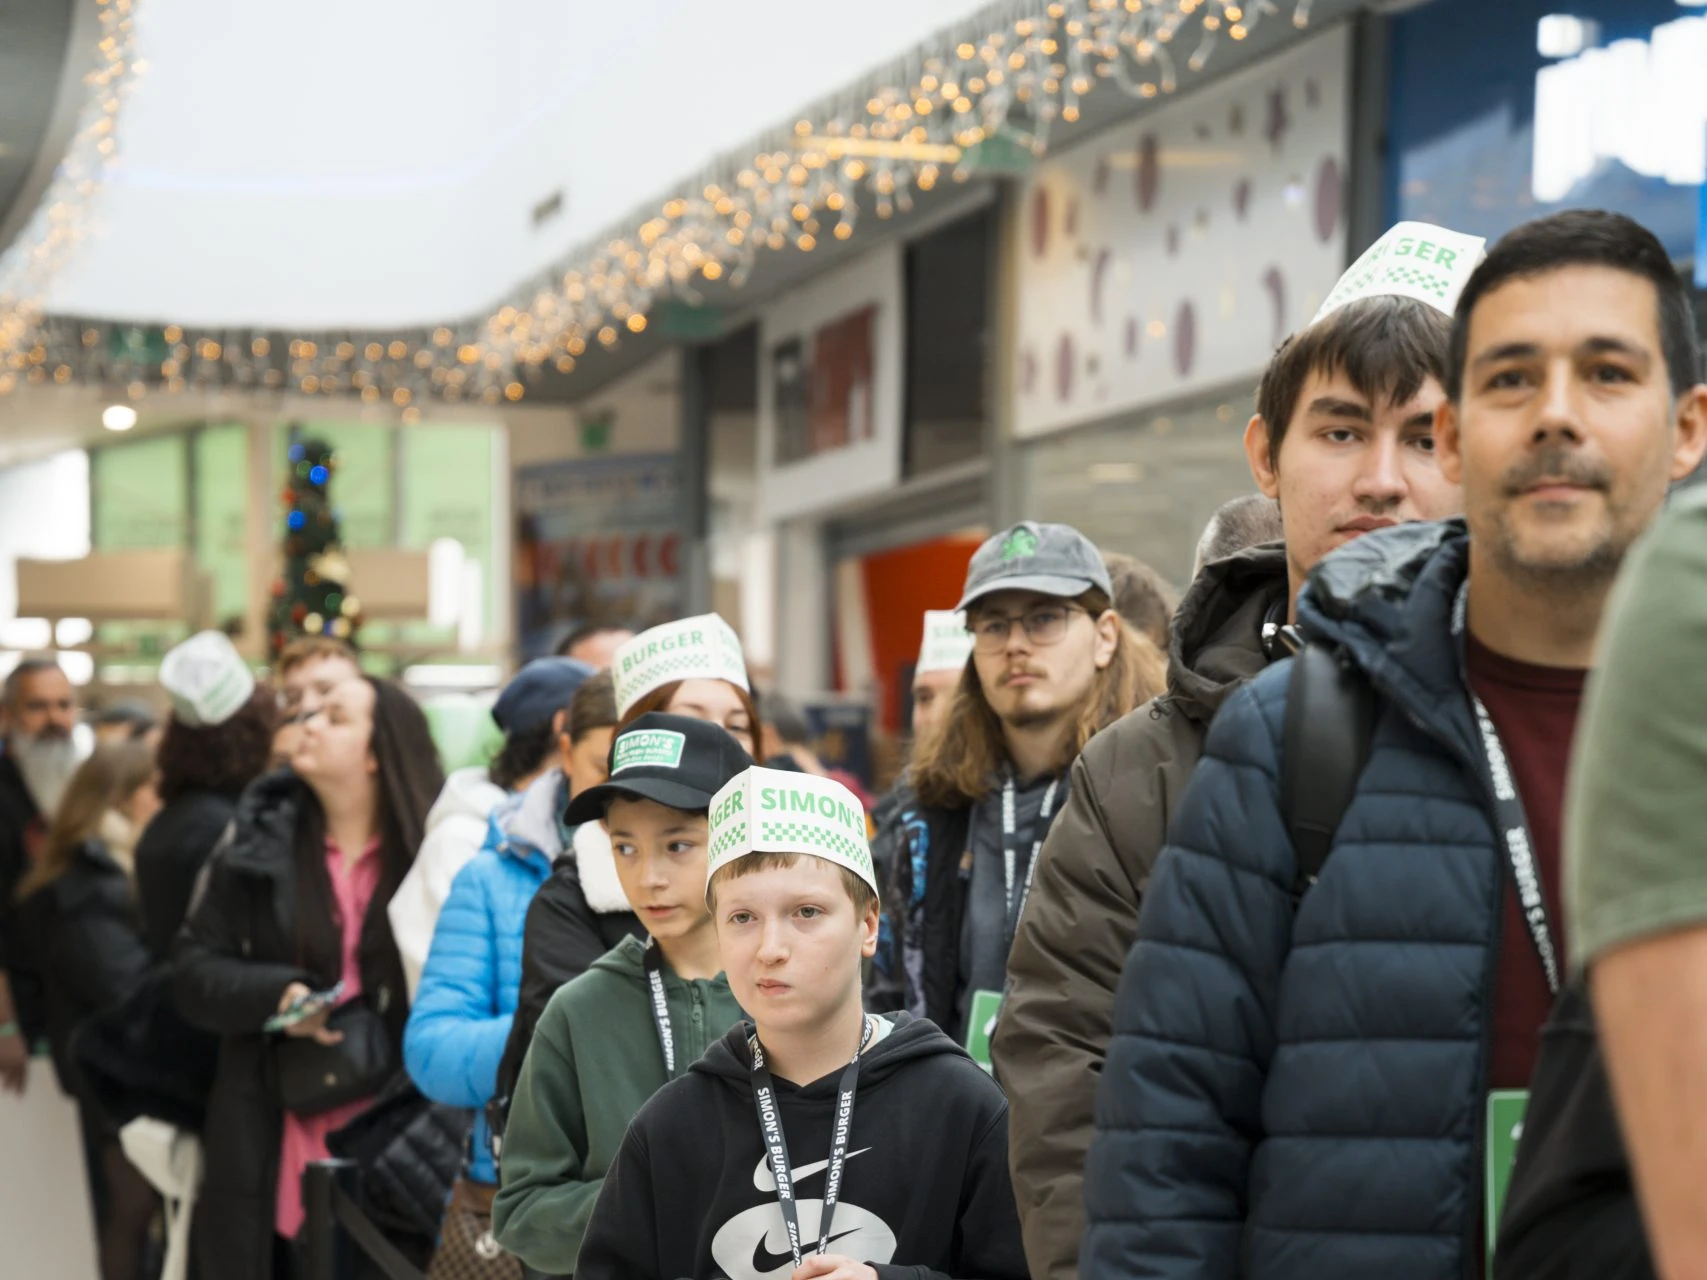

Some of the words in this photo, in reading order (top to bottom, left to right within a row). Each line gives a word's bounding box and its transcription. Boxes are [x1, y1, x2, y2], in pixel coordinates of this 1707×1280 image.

[622, 630, 704, 674] BURGER
[618, 734, 675, 754] SIMON'S
[761, 788, 864, 838] SIMON'S
[649, 969, 669, 1017] BURGER
[660, 1018, 675, 1071] SIMON'S
[757, 1087, 780, 1143] SIMON'S
[770, 1146, 791, 1199] BURGER
[826, 1147, 844, 1205] SIMON'S
[835, 1090, 852, 1145] BURGER
